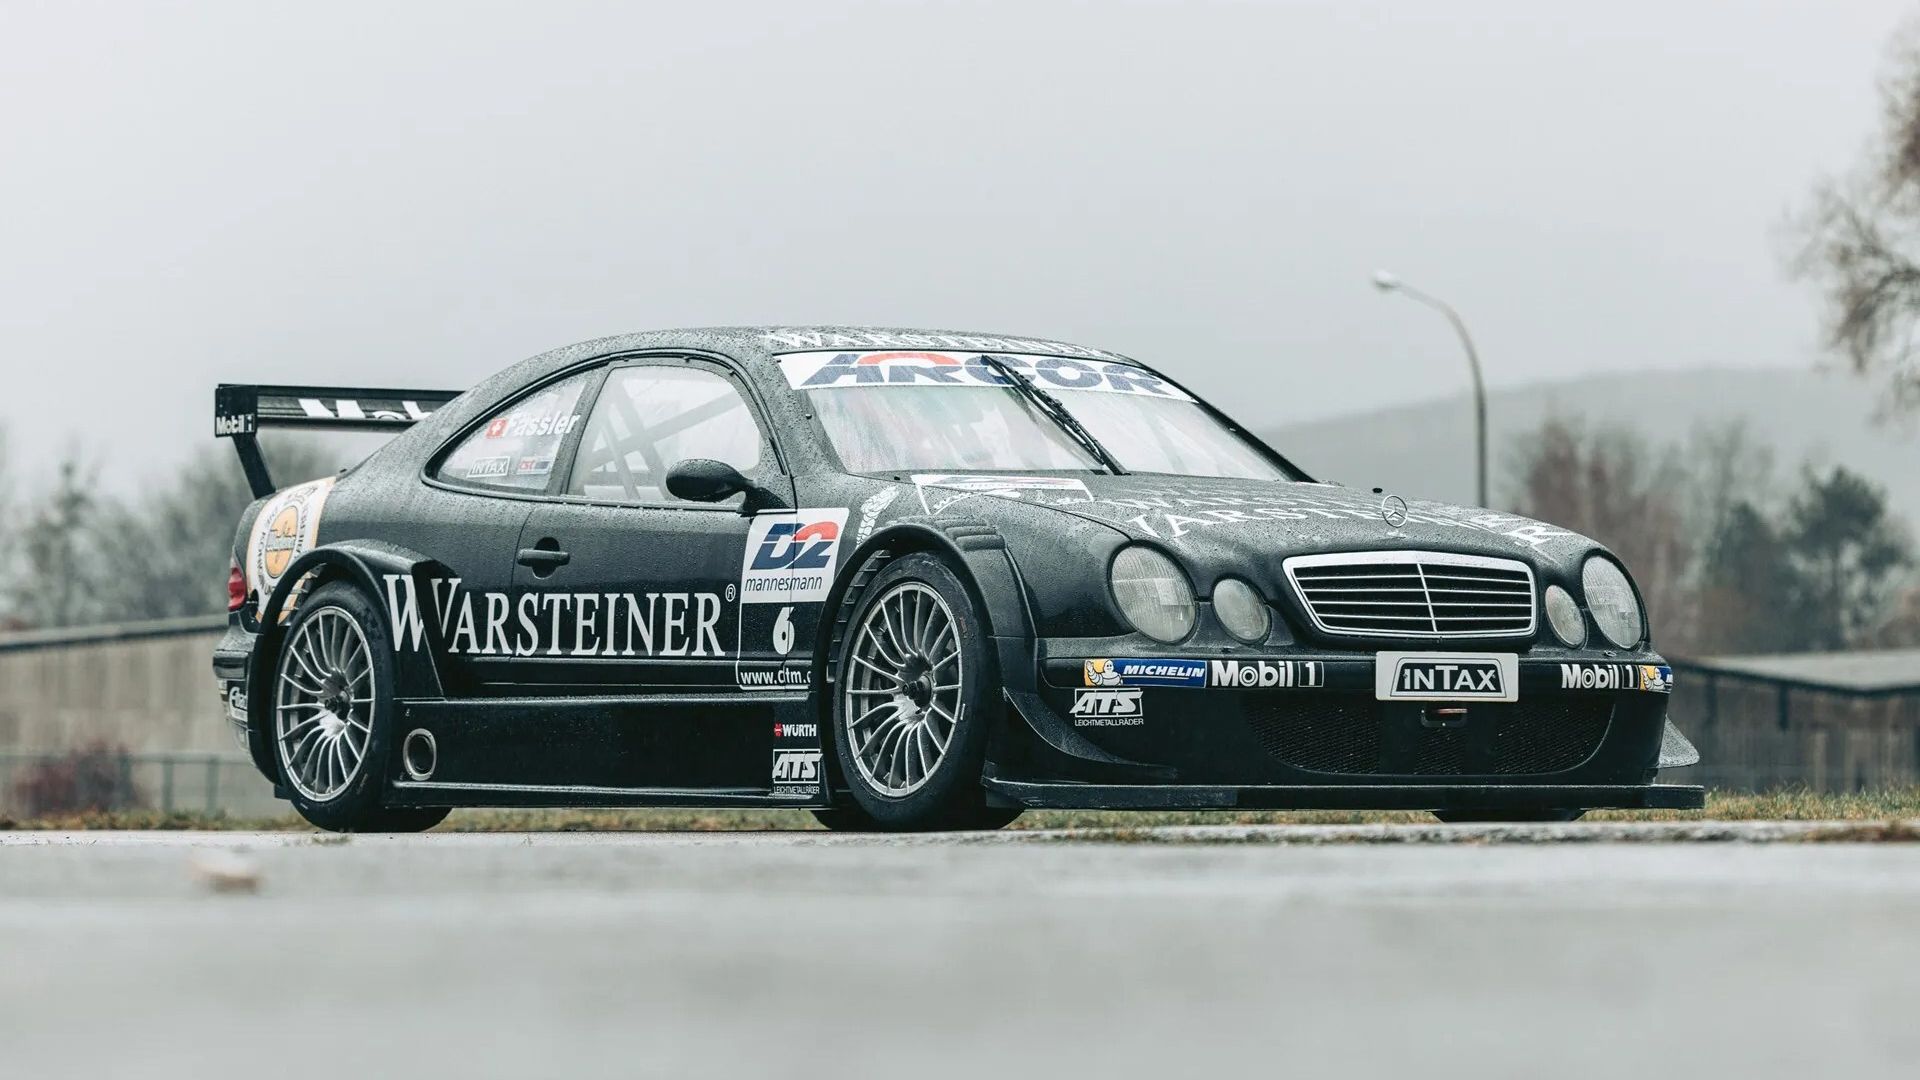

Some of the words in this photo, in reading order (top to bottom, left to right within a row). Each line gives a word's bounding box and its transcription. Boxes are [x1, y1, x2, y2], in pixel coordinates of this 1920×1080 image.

[801, 353, 1171, 394] ARCOR
[216, 414, 245, 434] Mobil
[750, 522, 839, 570] D2
[744, 576, 823, 592] mannesmann
[773, 607, 795, 655] 6
[1123, 665, 1205, 678] MICHELIN
[1212, 661, 1293, 687] Mobil
[1304, 662, 1316, 686] 1
[1404, 665, 1496, 690] INTAX
[1560, 664, 1619, 689] Mobil
[1625, 665, 1634, 688] 1
[1069, 690, 1144, 713] ATS
[782, 724, 817, 737] WÜRTH
[1075, 718, 1144, 727] LEICHTMETALLRÄDER
[772, 753, 823, 779] ATS
